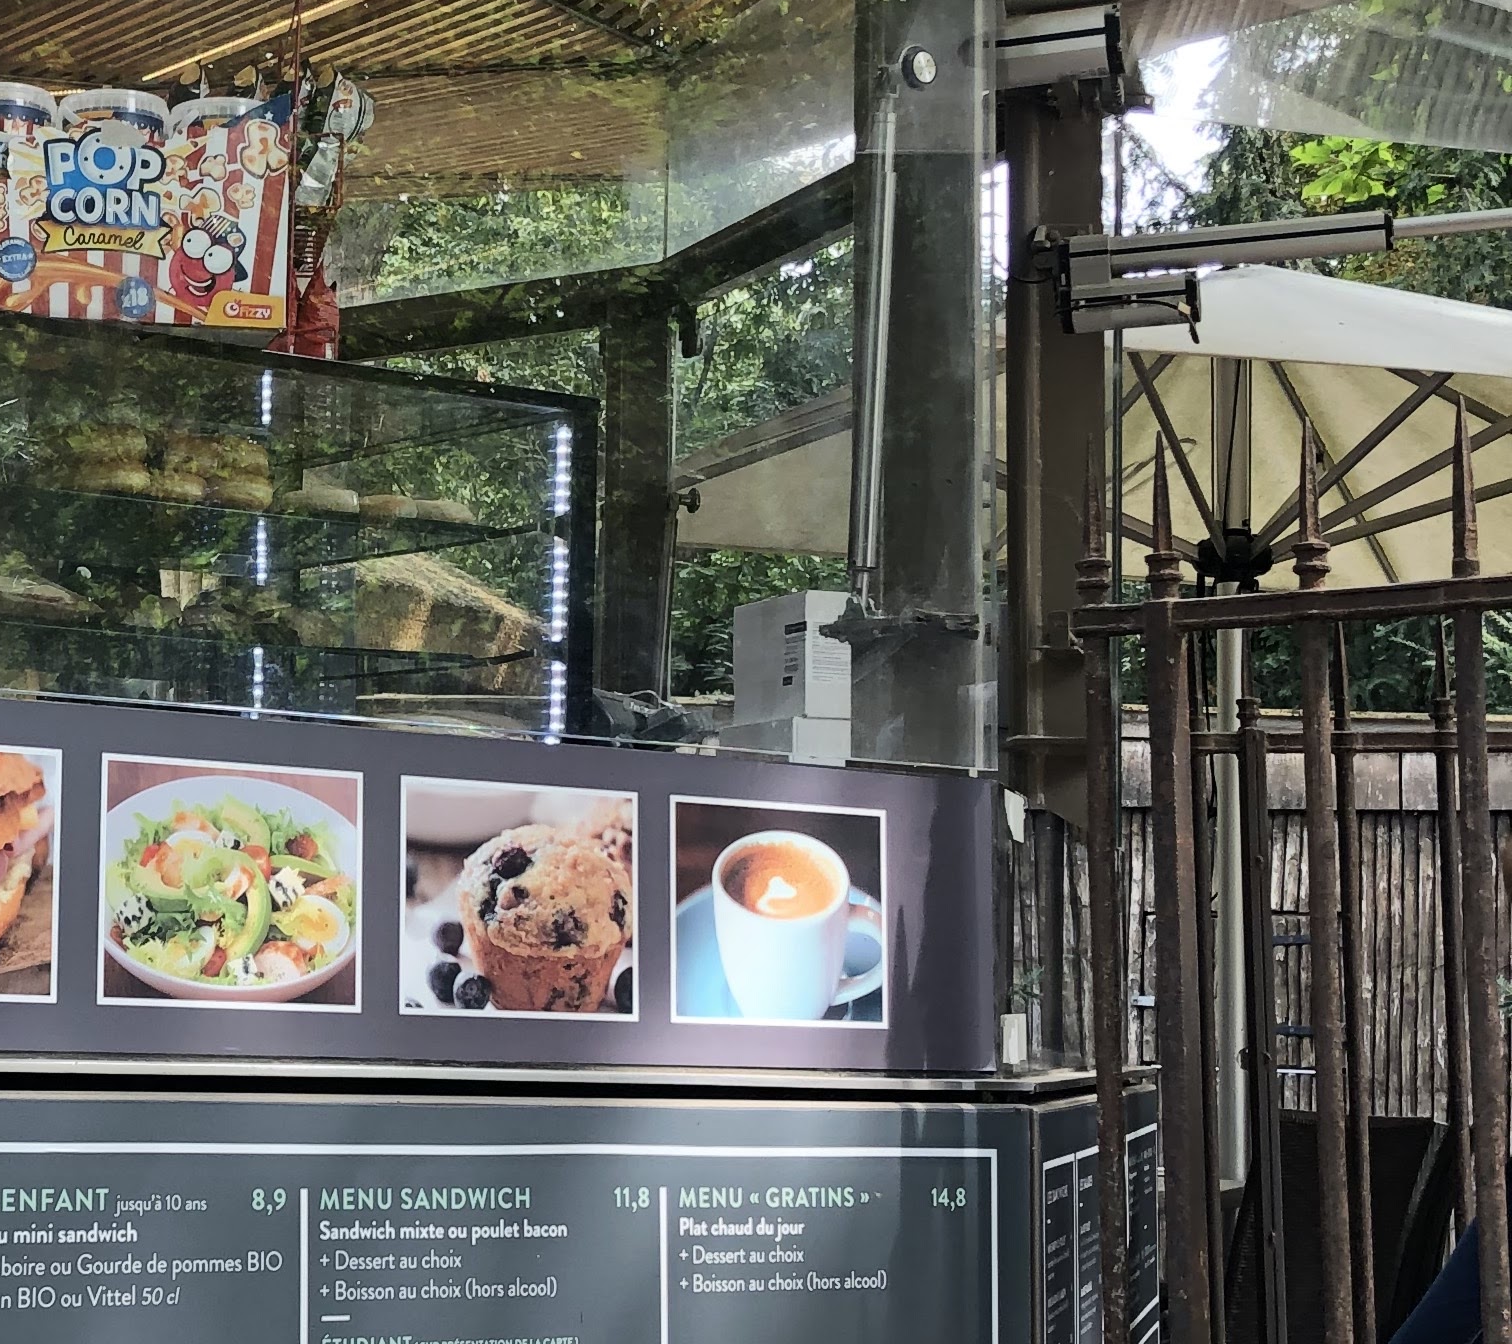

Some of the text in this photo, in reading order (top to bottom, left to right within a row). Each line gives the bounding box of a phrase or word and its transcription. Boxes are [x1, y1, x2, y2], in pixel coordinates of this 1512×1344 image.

[45, 129, 165, 191] POP
[50, 187, 159, 226] CORN
[63, 226, 146, 250] Caramel
[1, 1187, 110, 1212] ENFANT
[165, 1194, 182, 1211] 10
[184, 1199, 208, 1211] ans
[251, 1188, 287, 1216] 8,9
[319, 1186, 651, 1213] MENU SANDWICH 11,8
[678, 1186, 967, 1212] MENU GRATINS 14,8
[13, 1222, 54, 1244] mini
[57, 1221, 138, 1244] sandwich
[319, 1218, 568, 1246] Sandwich mixte ou poulet bacon
[679, 1216, 806, 1243] Plat chaud du jour
[0, 1255, 46, 1277] boire
[49, 1261, 72, 1276] ou
[76, 1252, 143, 1275] Gourde
[146, 1252, 168, 1274] de
[171, 1258, 243, 1281] pommes
[247, 1250, 283, 1272] BIO
[335, 1248, 462, 1271] Dessert au choix
[692, 1244, 805, 1265] Dessert au choix
[335, 1275, 558, 1301] Boisson au choix (hors alcool)
[692, 1269, 888, 1293] Boisson au choix (hors alcool)
[17, 1286, 56, 1309] BIO
[60, 1293, 83, 1308] ou
[86, 1284, 136, 1307] Vittel
[141, 1286, 164, 1306] 50
[166, 1286, 181, 1305] cl
